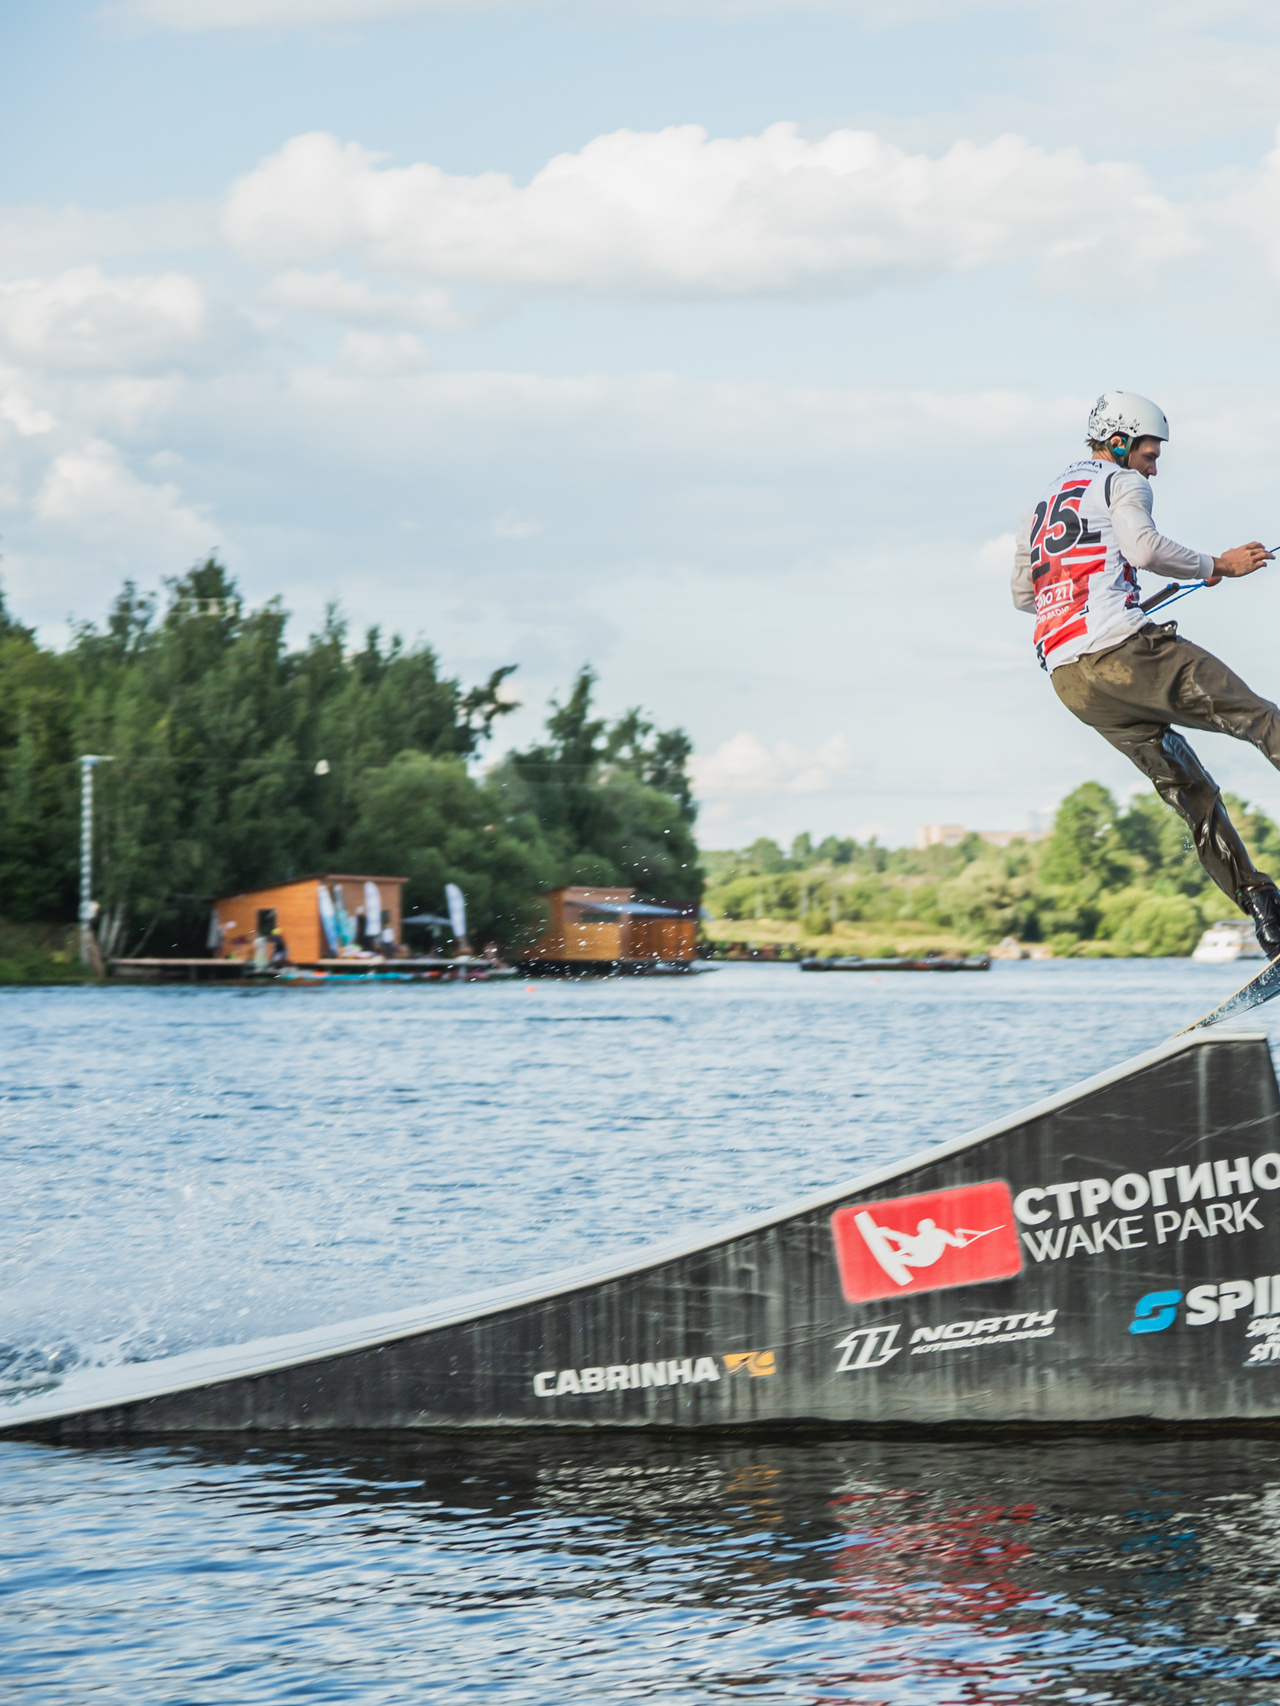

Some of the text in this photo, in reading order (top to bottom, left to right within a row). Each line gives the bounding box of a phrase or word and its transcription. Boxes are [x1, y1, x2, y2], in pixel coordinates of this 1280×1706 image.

[1030, 486, 1087, 567] 25
[1020, 1197, 1265, 1263] WAKE PARK
[908, 1308, 1059, 1345] NORTH
[909, 1326, 1056, 1356] KITEBOARDING
[533, 1356, 721, 1398] CABRINHA
